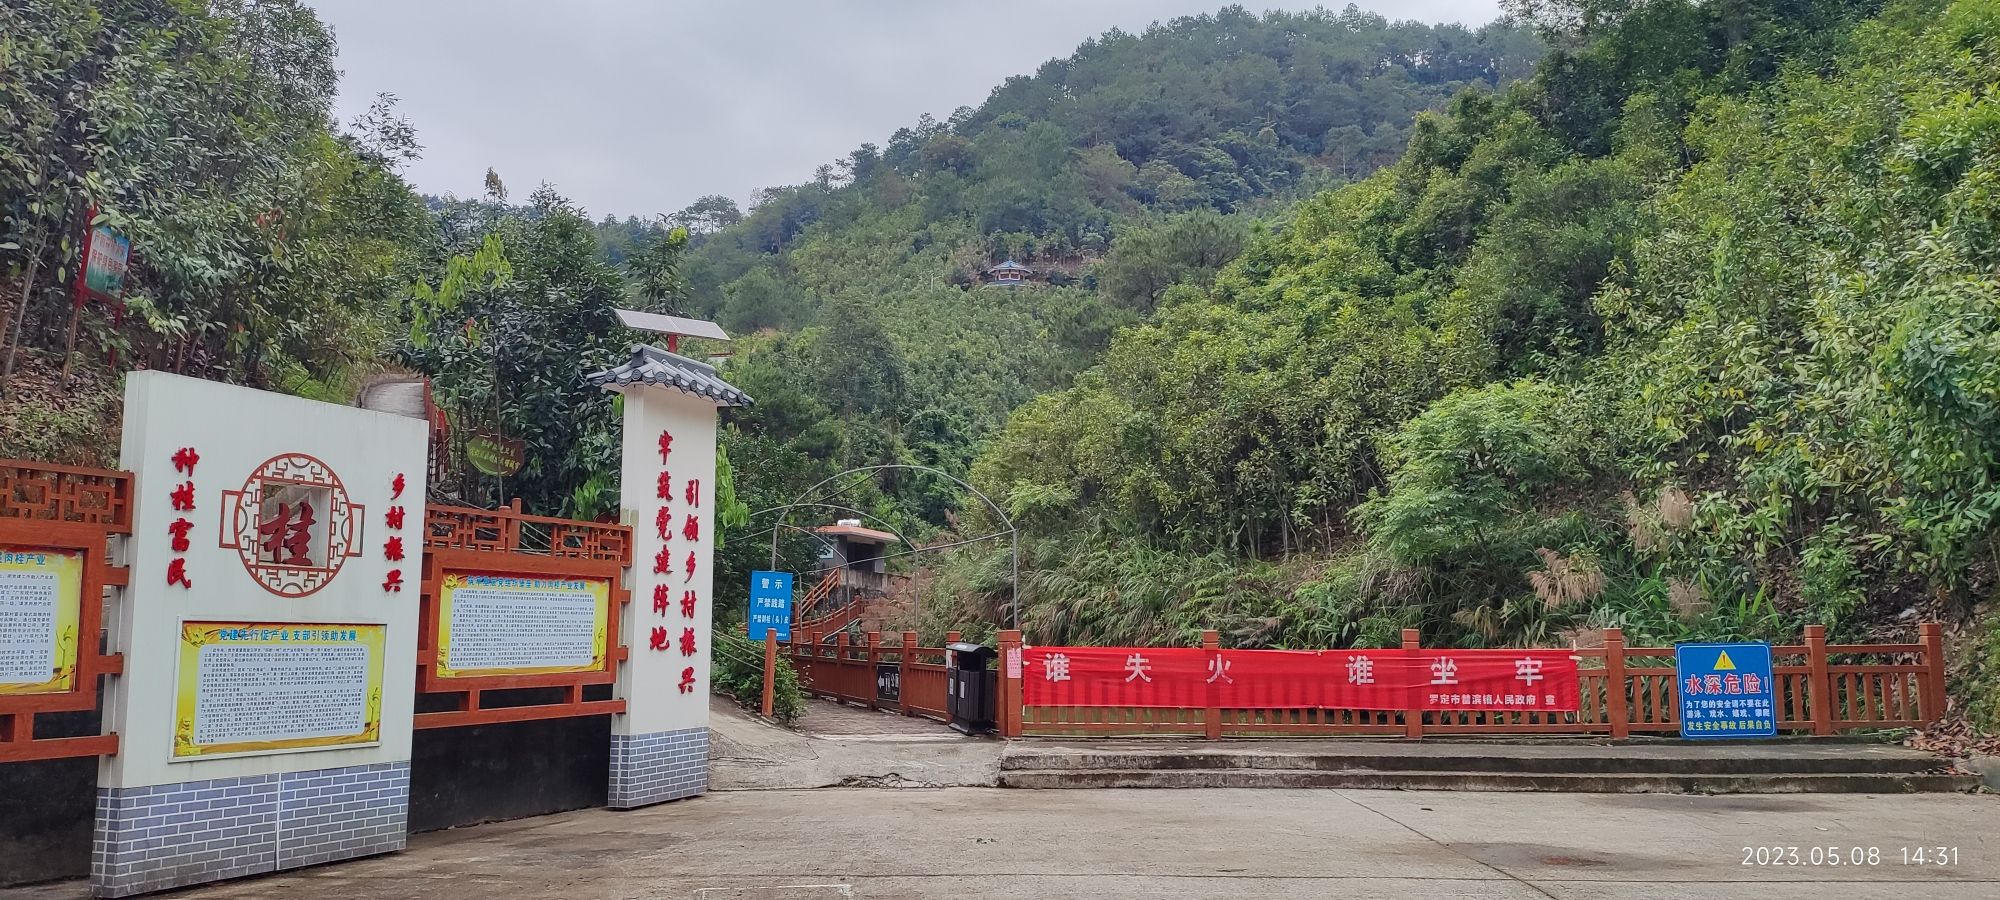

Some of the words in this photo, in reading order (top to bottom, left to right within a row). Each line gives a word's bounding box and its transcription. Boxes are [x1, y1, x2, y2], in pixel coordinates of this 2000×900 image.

[167, 447, 200, 589] 种桂富民
[261, 502, 316, 566] 桂
[382, 473, 406, 592] 乡村振兴
[650, 430, 674, 651] 牢筑党建阵地
[0, 552, 46, 566] 肉桂产业
[678, 479, 700, 694] 引领乡村振兴
[762, 577, 783, 590] 警示
[757, 597, 785, 609] 严禁践踏
[219, 629, 289, 641] 党建先行促产业
[293, 630, 357, 641] 支部引领助发展
[1043, 653, 1234, 684] 谁失火
[1345, 655, 1544, 687] 谁坐牢
[1685, 673, 1770, 695] 水深危险！
[1544, 694, 1556, 706] 宣
[1686, 699, 1770, 709] 为了您的安全请不要在此
[1687, 721, 1737, 731] 发生安全事故
[1739, 720, 1771, 730] 后果自负
